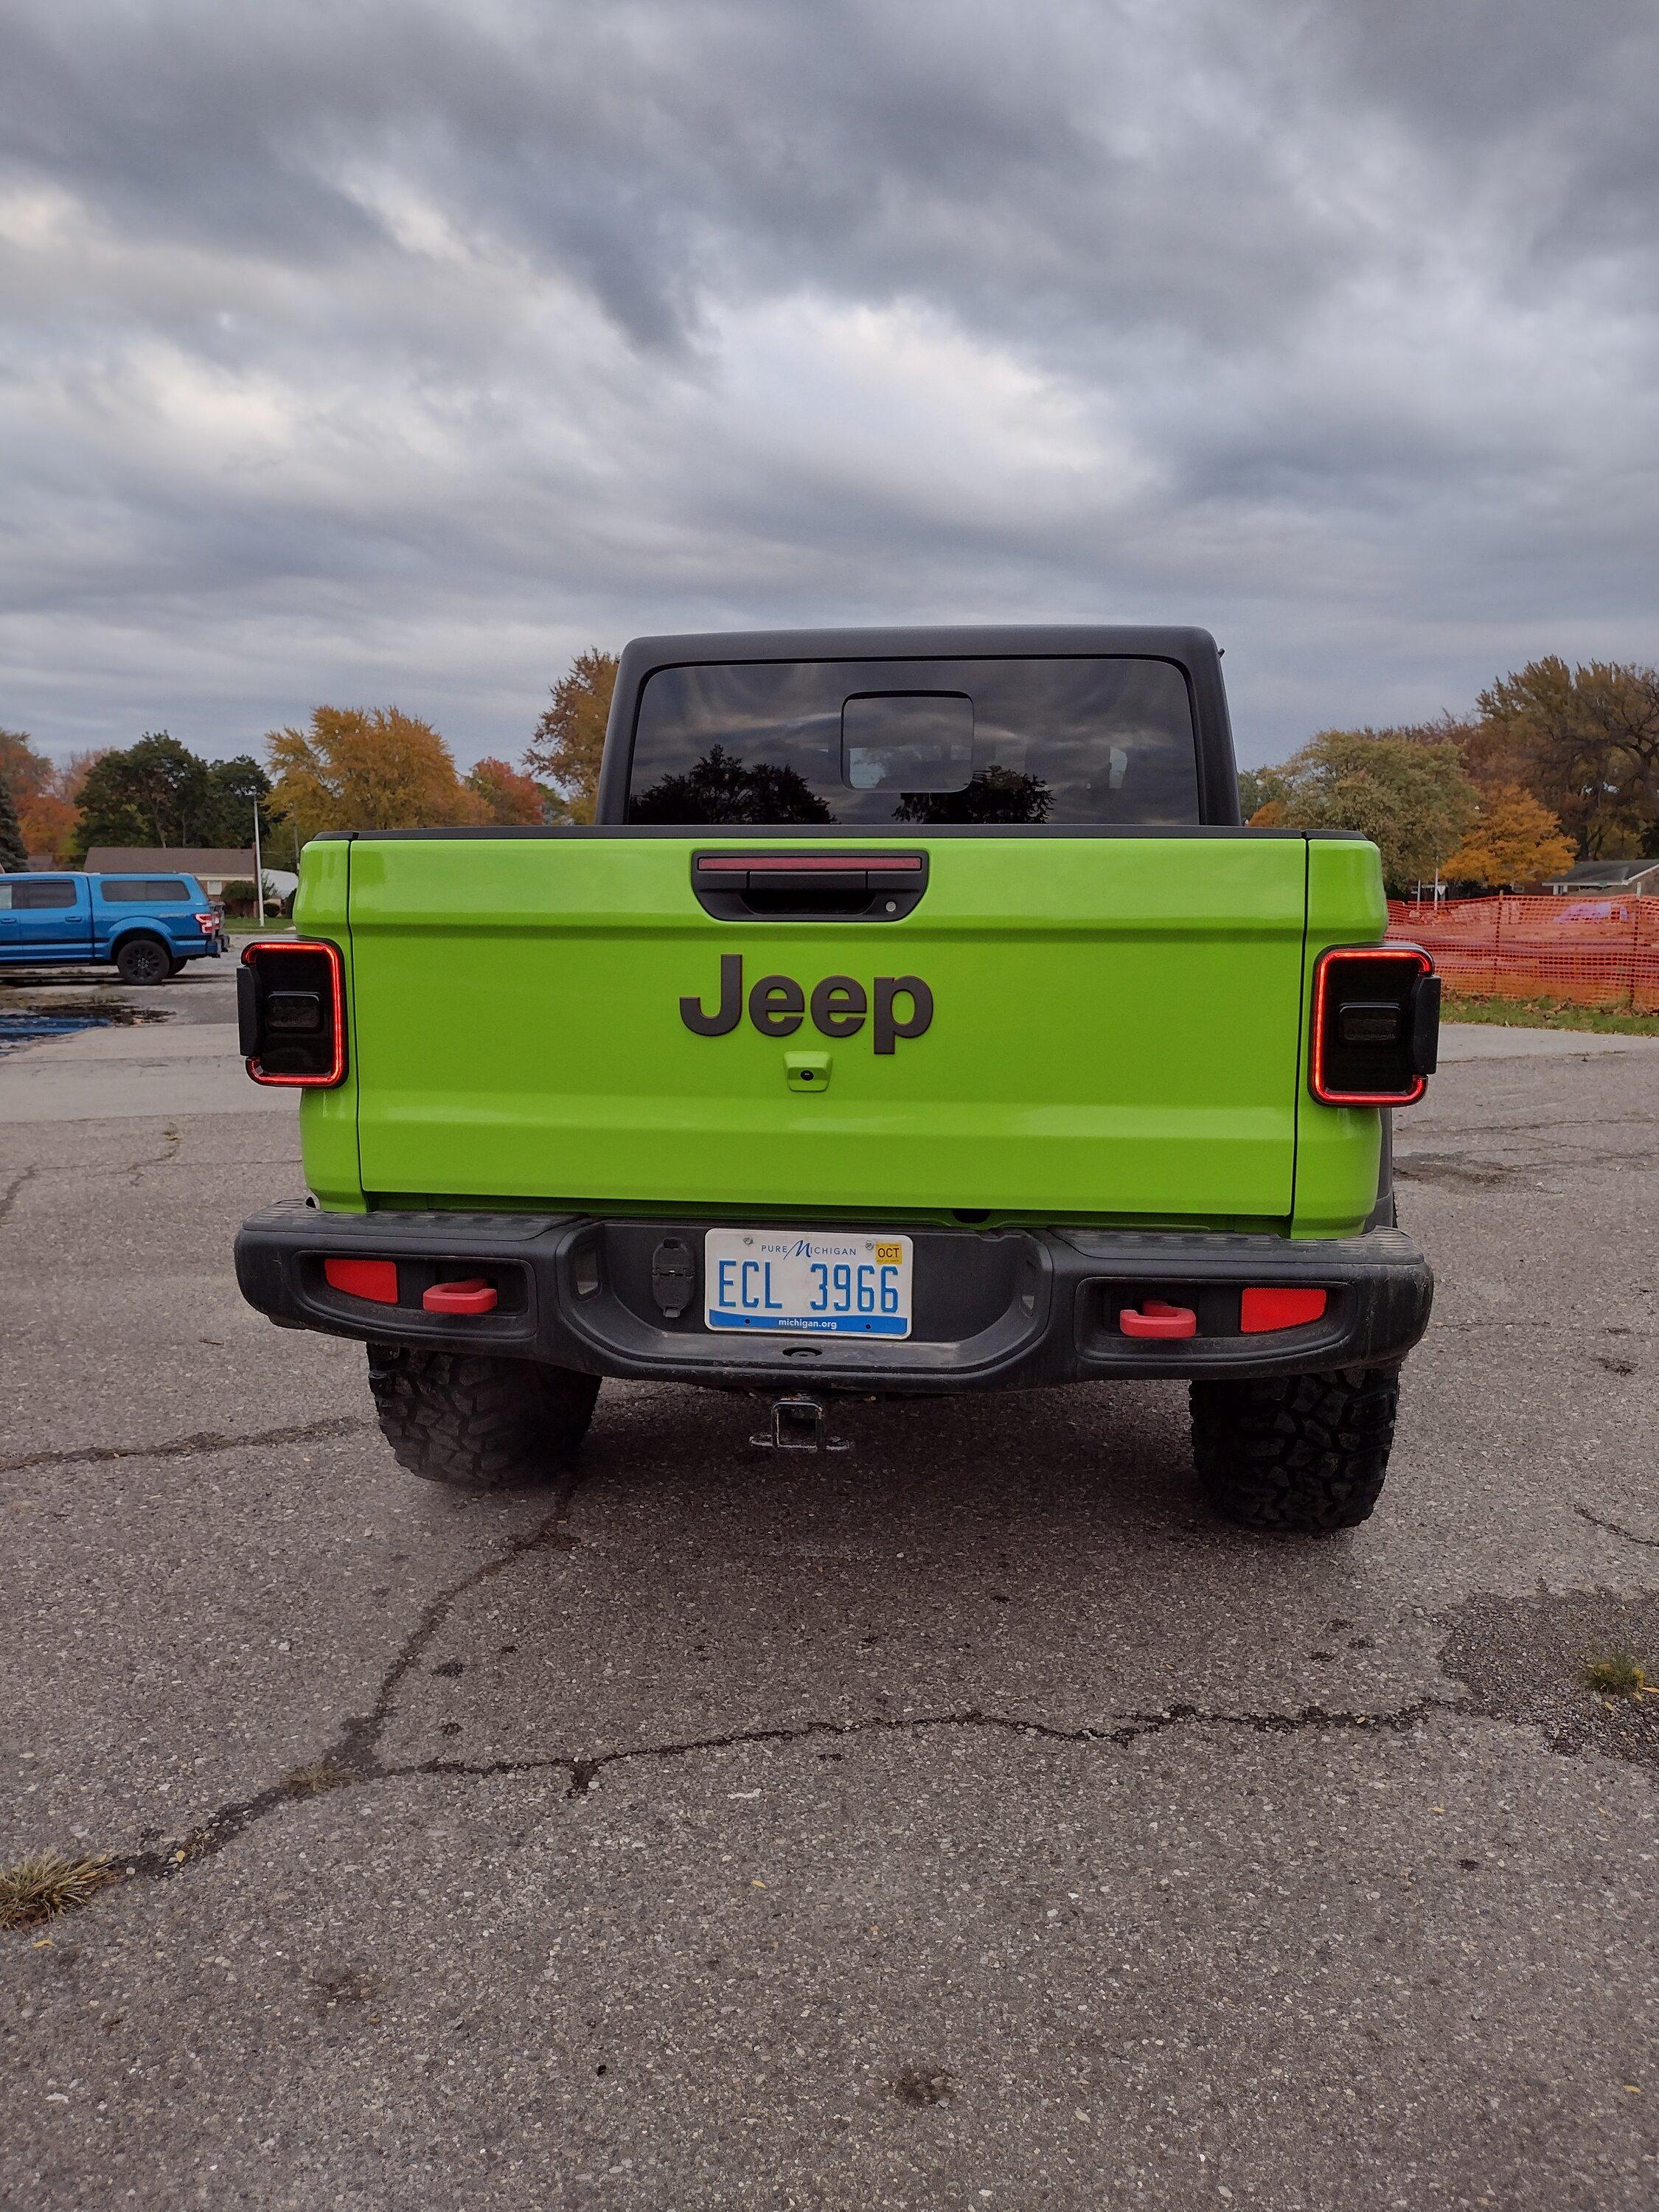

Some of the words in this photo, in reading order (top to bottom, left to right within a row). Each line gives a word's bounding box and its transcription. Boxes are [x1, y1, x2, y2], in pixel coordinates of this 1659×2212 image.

[679, 953, 933, 1054] Jeep
[761, 1245, 788, 1253] PURE
[783, 1239, 856, 1260] MICHIGAN
[877, 1248, 900, 1258] OCT
[719, 1259, 782, 1309] ECL
[810, 1263, 899, 1313] 3966
[779, 1318, 837, 1329] michigan.org
